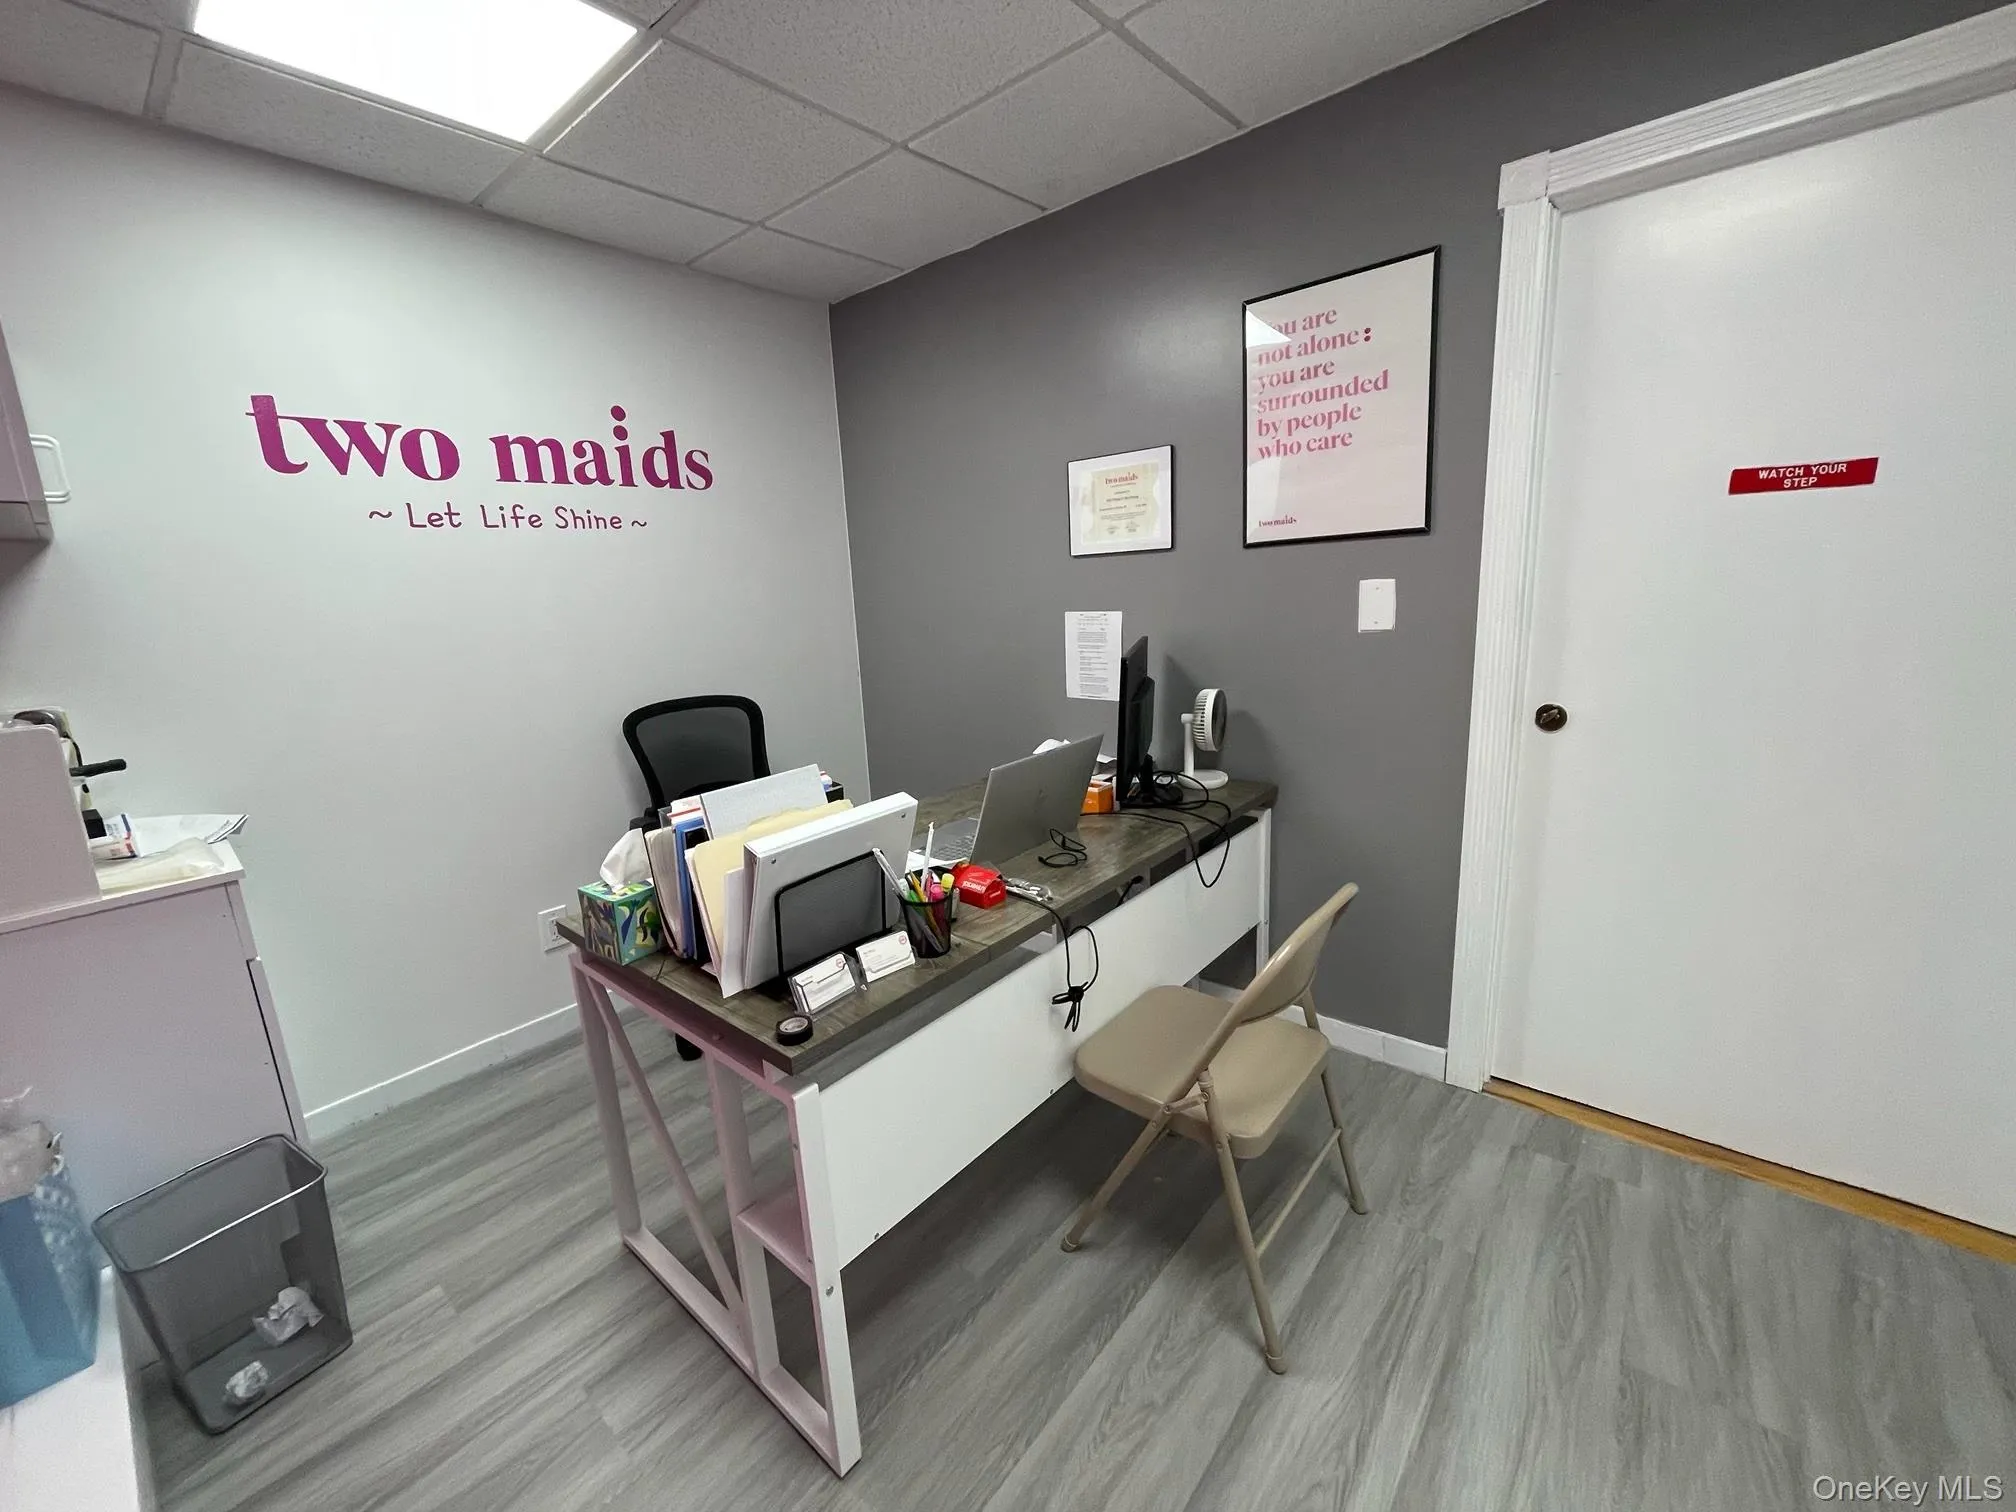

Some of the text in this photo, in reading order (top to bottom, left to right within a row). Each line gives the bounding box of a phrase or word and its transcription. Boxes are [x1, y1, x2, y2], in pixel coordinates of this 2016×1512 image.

[1302, 309, 1337, 331] are
[1258, 344, 1293, 366] not
[1257, 368, 1389, 414] surrounded
[1258, 360, 1335, 395] you are
[1257, 402, 1363, 440] by people
[245, 394, 713, 491] two maids
[1258, 432, 1353, 460] who care
[1758, 463, 1847, 480] WATCH YOUR
[1783, 476, 1817, 489] STEP
[405, 501, 462, 530] Let
[480, 504, 543, 530] Life
[554, 506, 623, 531] Shine
